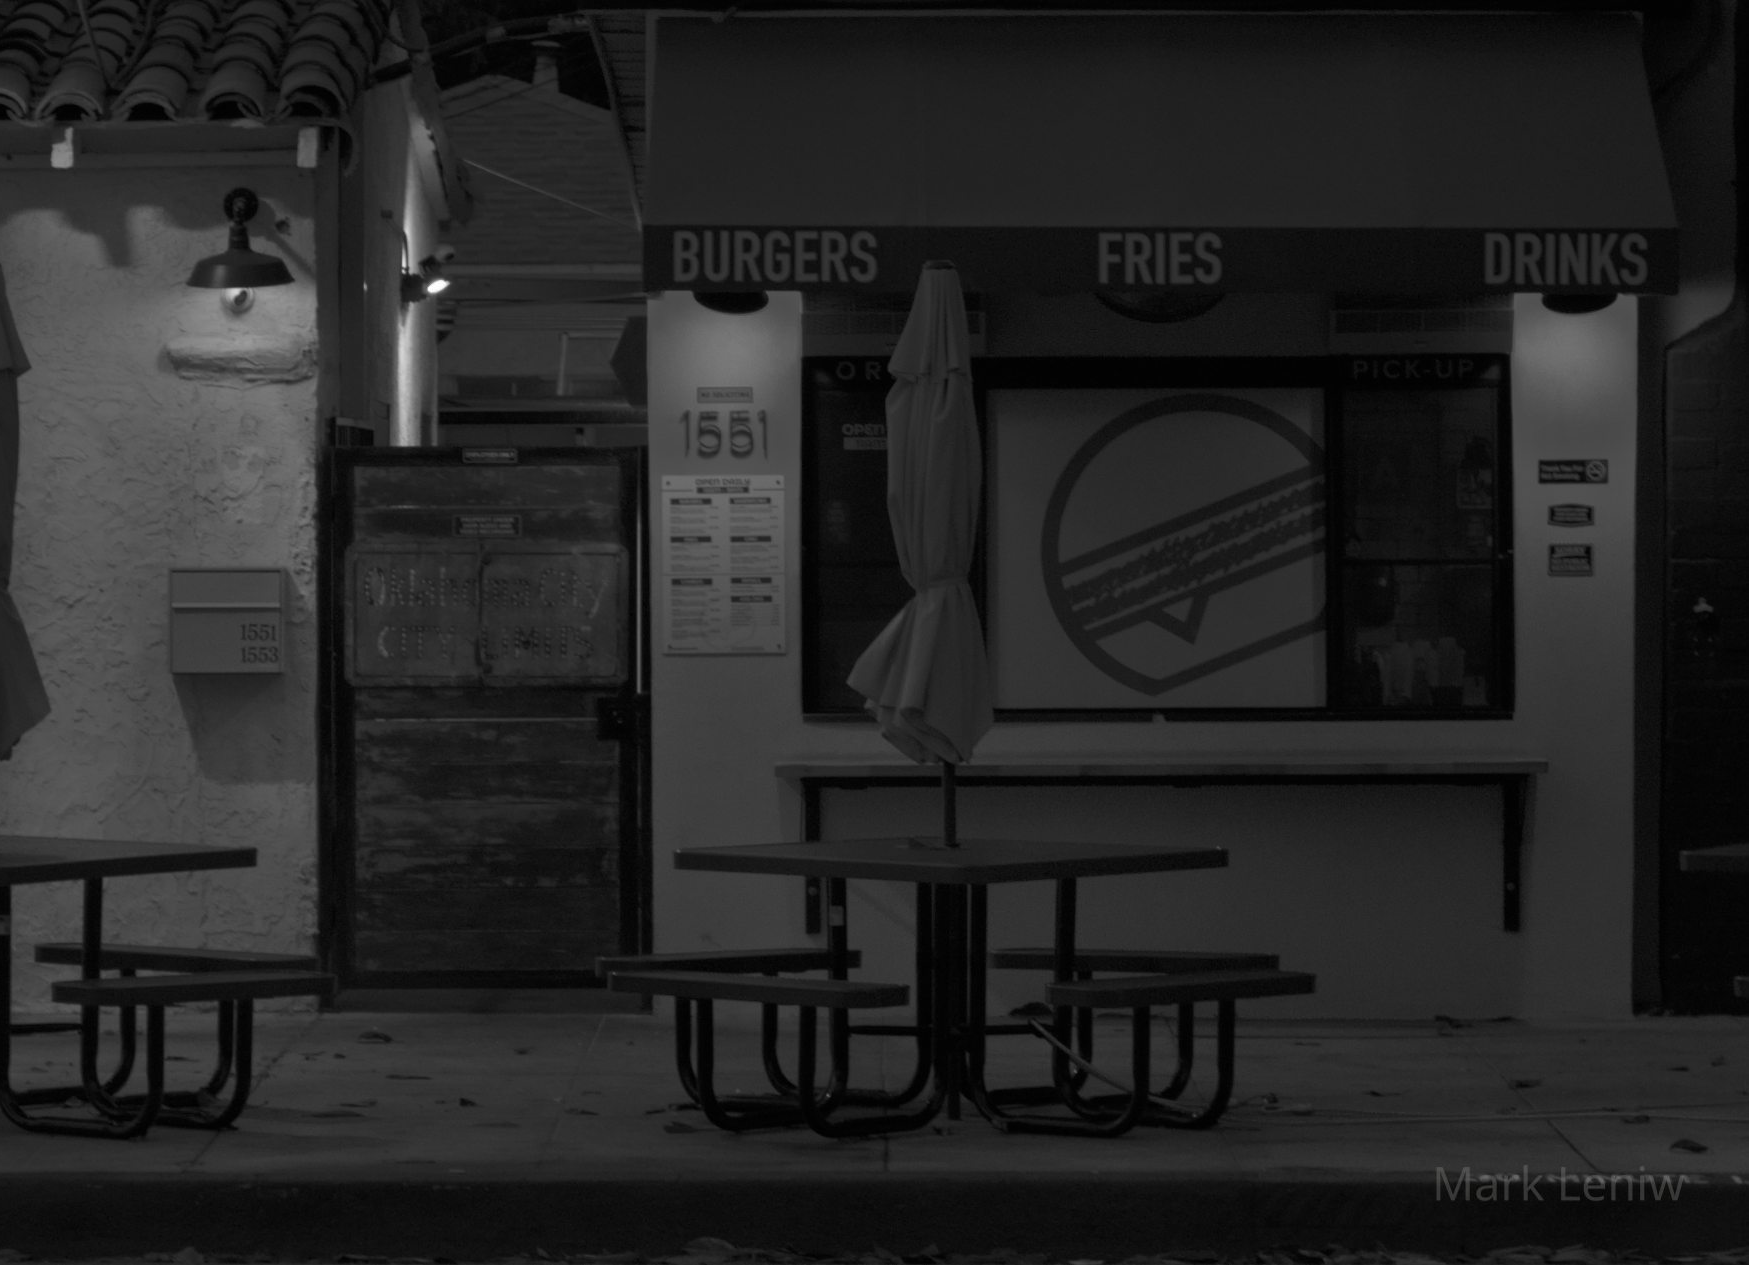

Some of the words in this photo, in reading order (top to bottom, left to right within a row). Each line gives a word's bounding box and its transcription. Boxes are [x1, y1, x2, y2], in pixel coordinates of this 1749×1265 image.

[671, 230, 879, 286] BURGERS
[1096, 232, 1223, 287] FRIES
[1482, 231, 1649, 287] DRINKS
[1353, 357, 1476, 381] PICK-UP
[680, 409, 769, 460] 1551
[240, 623, 277, 641] 1551
[240, 646, 279, 663] 1553
